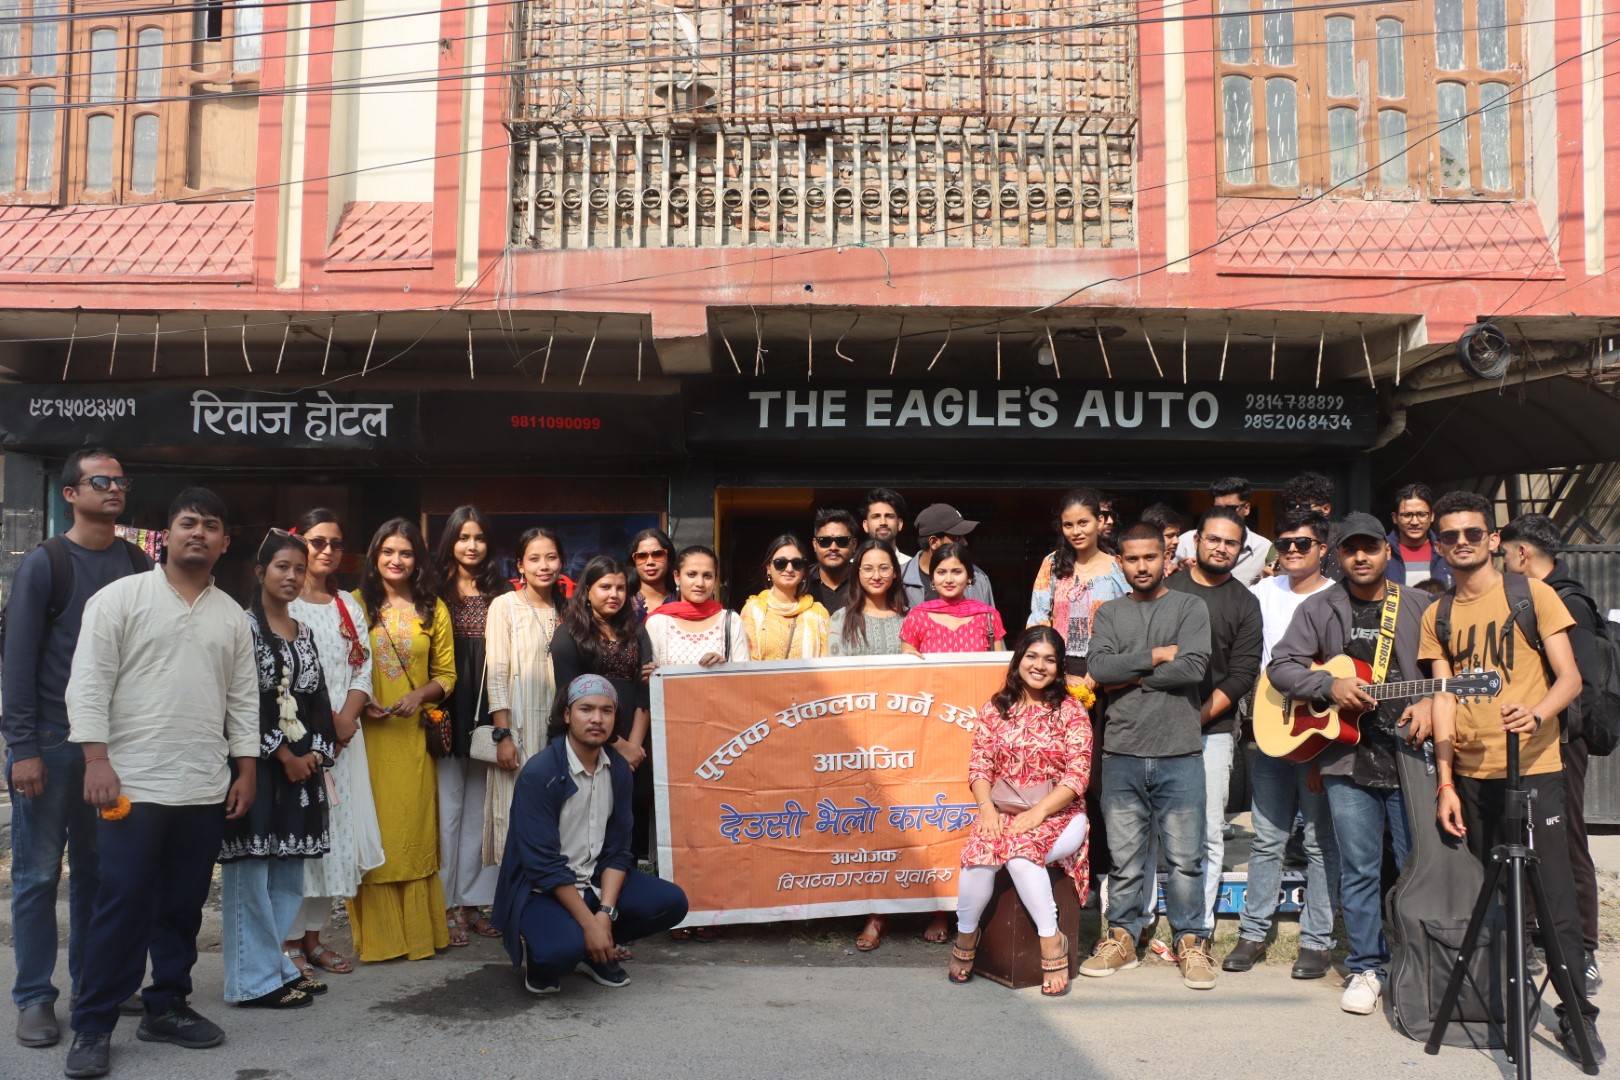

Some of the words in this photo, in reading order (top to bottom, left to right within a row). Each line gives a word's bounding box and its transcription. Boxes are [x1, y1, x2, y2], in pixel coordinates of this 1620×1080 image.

[748, 390, 847, 428] THE
[866, 385, 1059, 428] EAGLE'S
[1074, 389, 1220, 429] AUTO
[1245, 394, 1344, 410] 9814788899
[191, 390, 299, 436] रिवाज
[305, 390, 394, 441] होटल
[511, 415, 601, 430] 9811090099
[1244, 414, 1352, 430] 9852068434
[1385, 601, 1397, 613] DO
[695, 718, 772, 781] पुस्तक
[775, 692, 879, 729] संकलन
[887, 690, 935, 717] गर्ने
[813, 744, 916, 773] आयोजित
[718, 799, 810, 844] देउसी
[815, 796, 882, 836] भैलो
[888, 792, 980, 833] कार्यक्र
[777, 869, 889, 891] विराटनगरका
